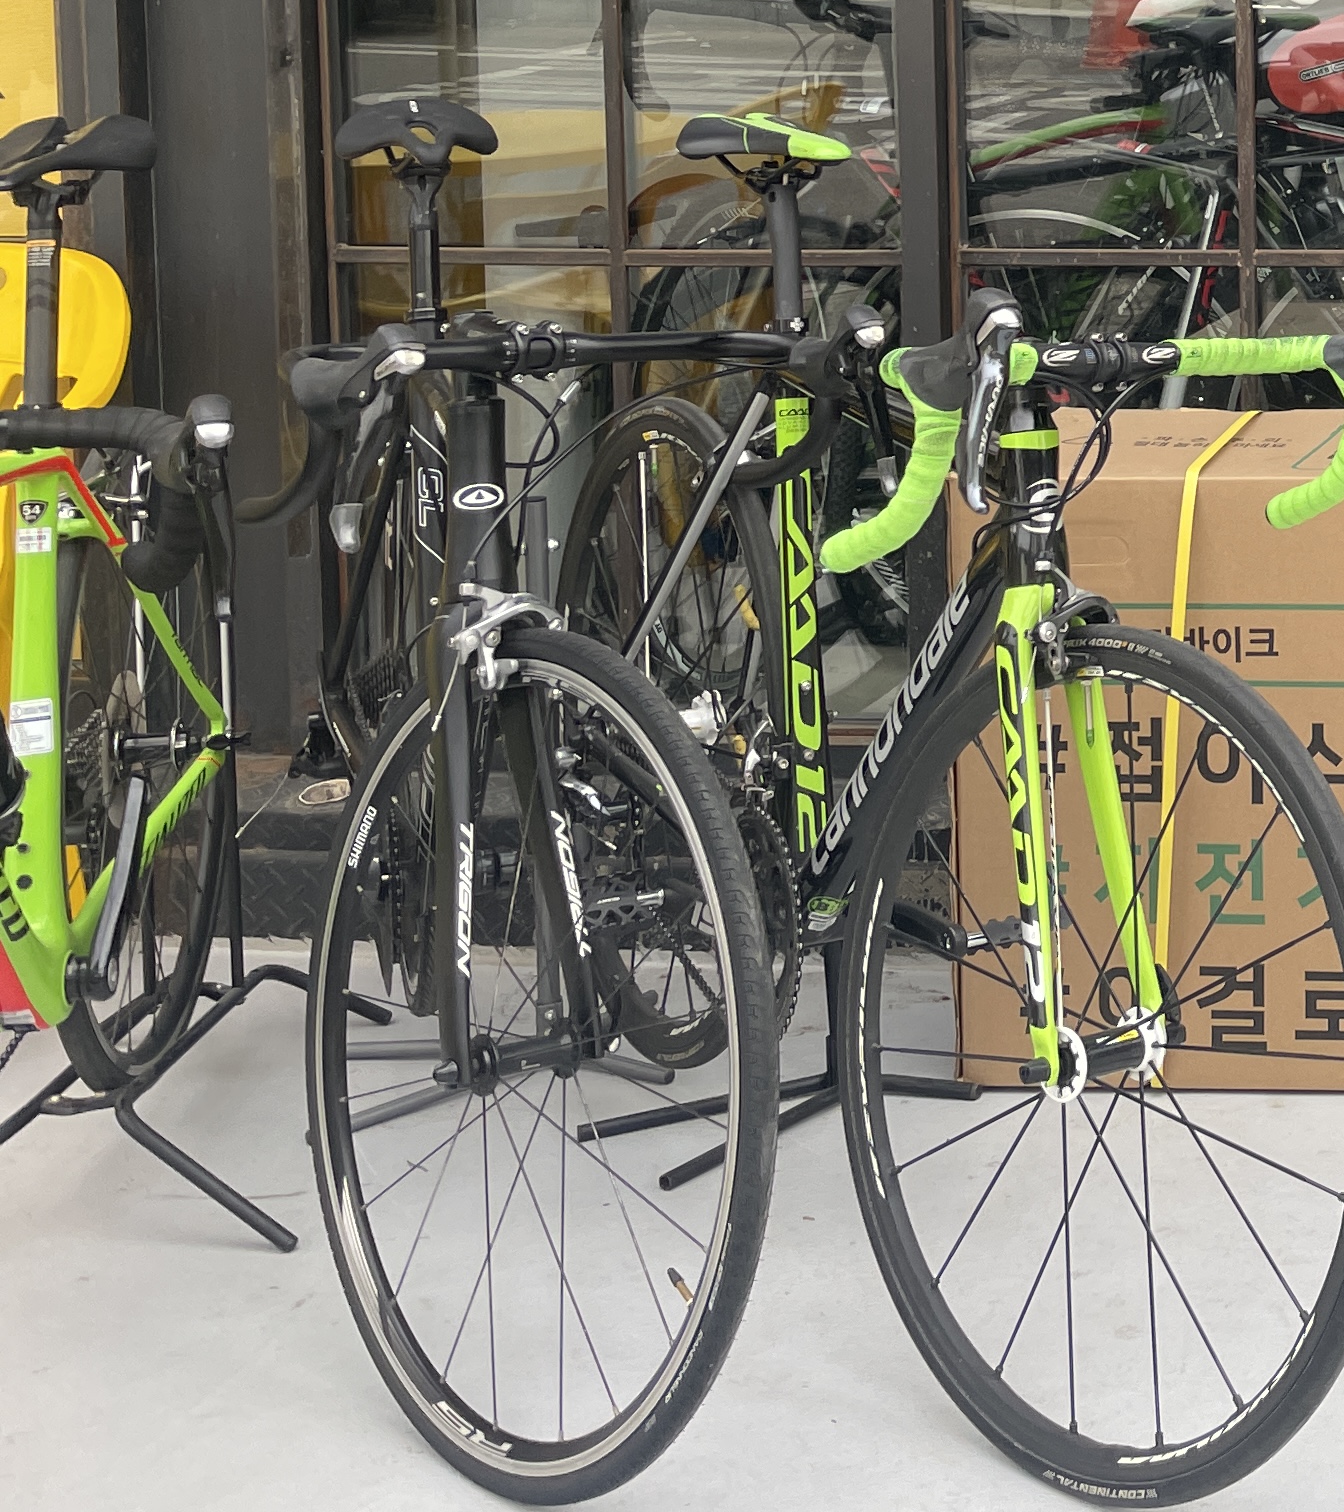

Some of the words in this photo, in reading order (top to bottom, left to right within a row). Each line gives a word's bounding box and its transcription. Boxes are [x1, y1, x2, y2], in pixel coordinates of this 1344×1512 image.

[346, 804, 378, 870] SHIMANO
[456, 821, 475, 979] TRIGON
[1056, 1473, 1147, 1500] CONTINENTAL
